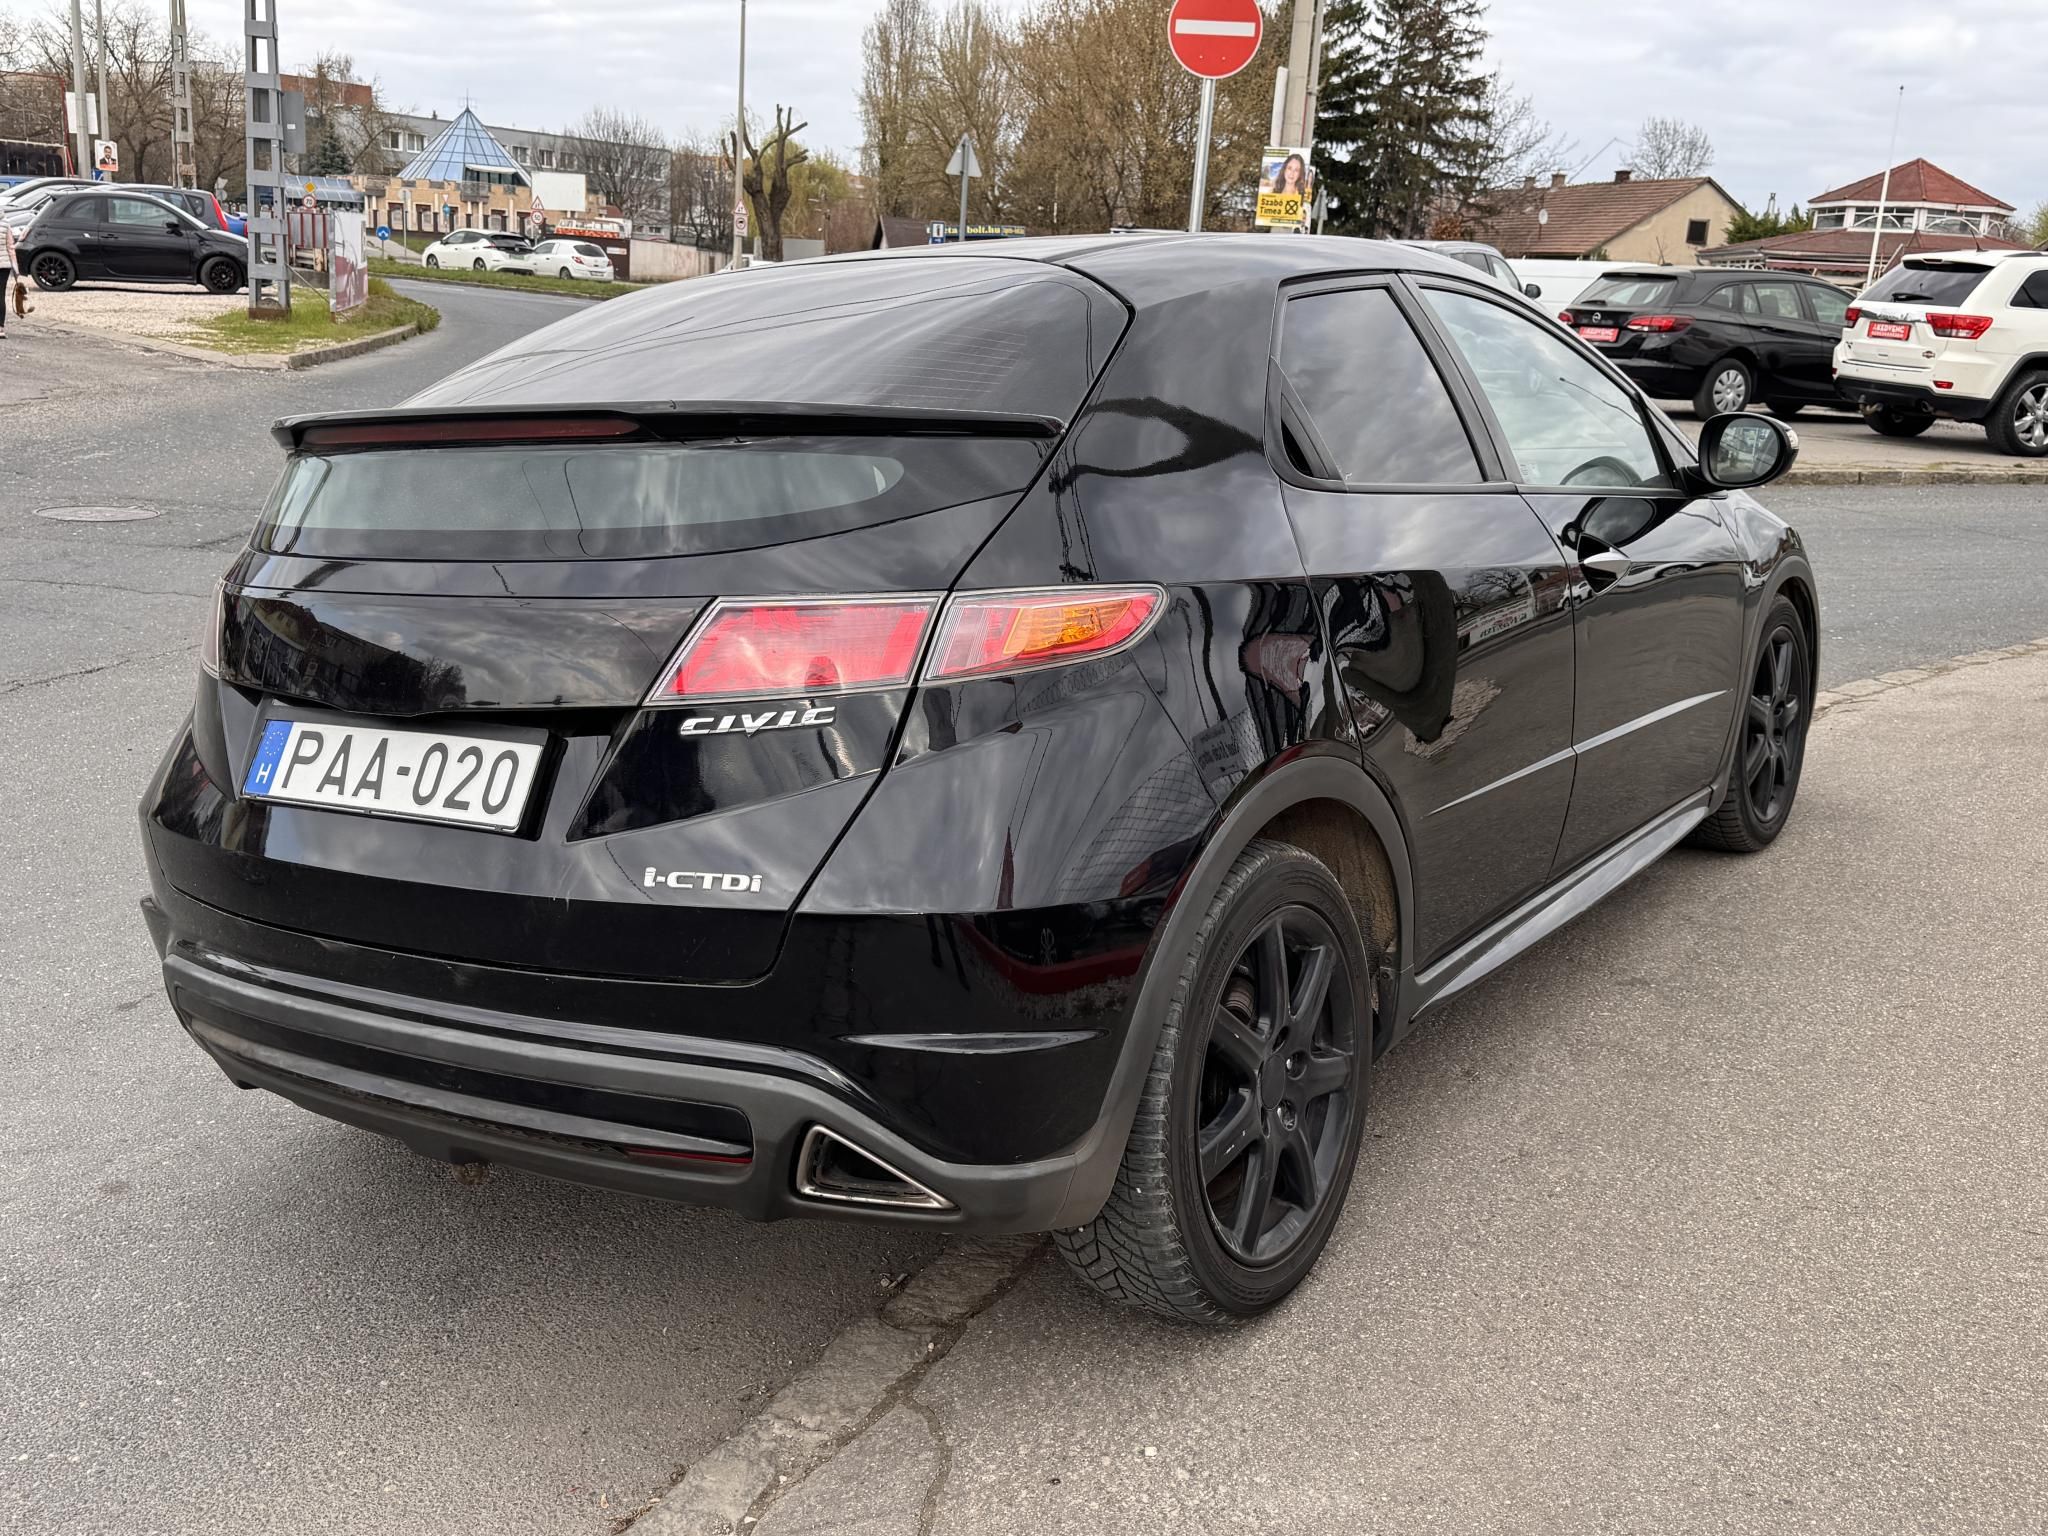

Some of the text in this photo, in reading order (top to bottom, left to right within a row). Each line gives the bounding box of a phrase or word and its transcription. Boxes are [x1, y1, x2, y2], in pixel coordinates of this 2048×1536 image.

[680, 706, 836, 738] CIVIC
[255, 762, 272, 784] H
[281, 730, 520, 815] PAA-020
[643, 866, 763, 893] i-CTDi
